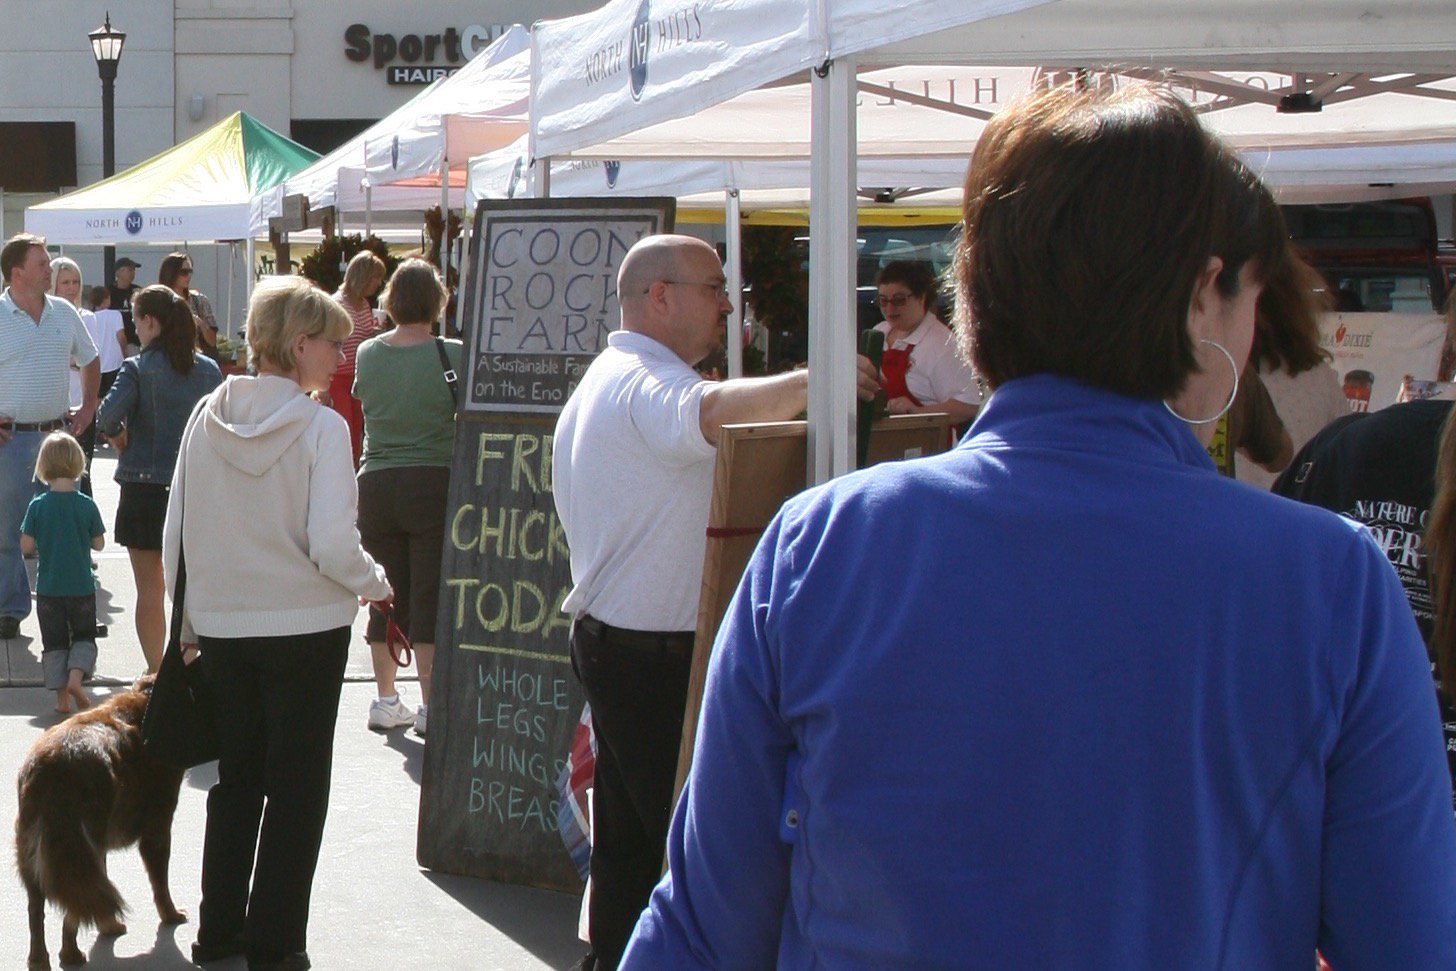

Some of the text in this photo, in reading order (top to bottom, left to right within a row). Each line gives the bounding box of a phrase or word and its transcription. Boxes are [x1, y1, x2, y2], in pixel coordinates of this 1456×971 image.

[585, 40, 623, 87] NORTH
[656, 3, 701, 53] HILLS
[86, 219, 119, 228] NORTH
[149, 216, 183, 226] HILLS
[491, 227, 645, 269] COON
[490, 271, 618, 316] ROCK
[477, 355, 491, 371] A
[493, 354, 559, 375] Sustainable
[475, 382, 495, 397] on
[500, 380, 526, 398] the
[531, 381, 562, 401] Eno
[451, 503, 569, 566] CHICK
[1355, 499, 1418, 526] NATURE
[478, 663, 569, 710] WHOLE
[477, 696, 546, 743] LEGS
[469, 777, 559, 833] BREAS
